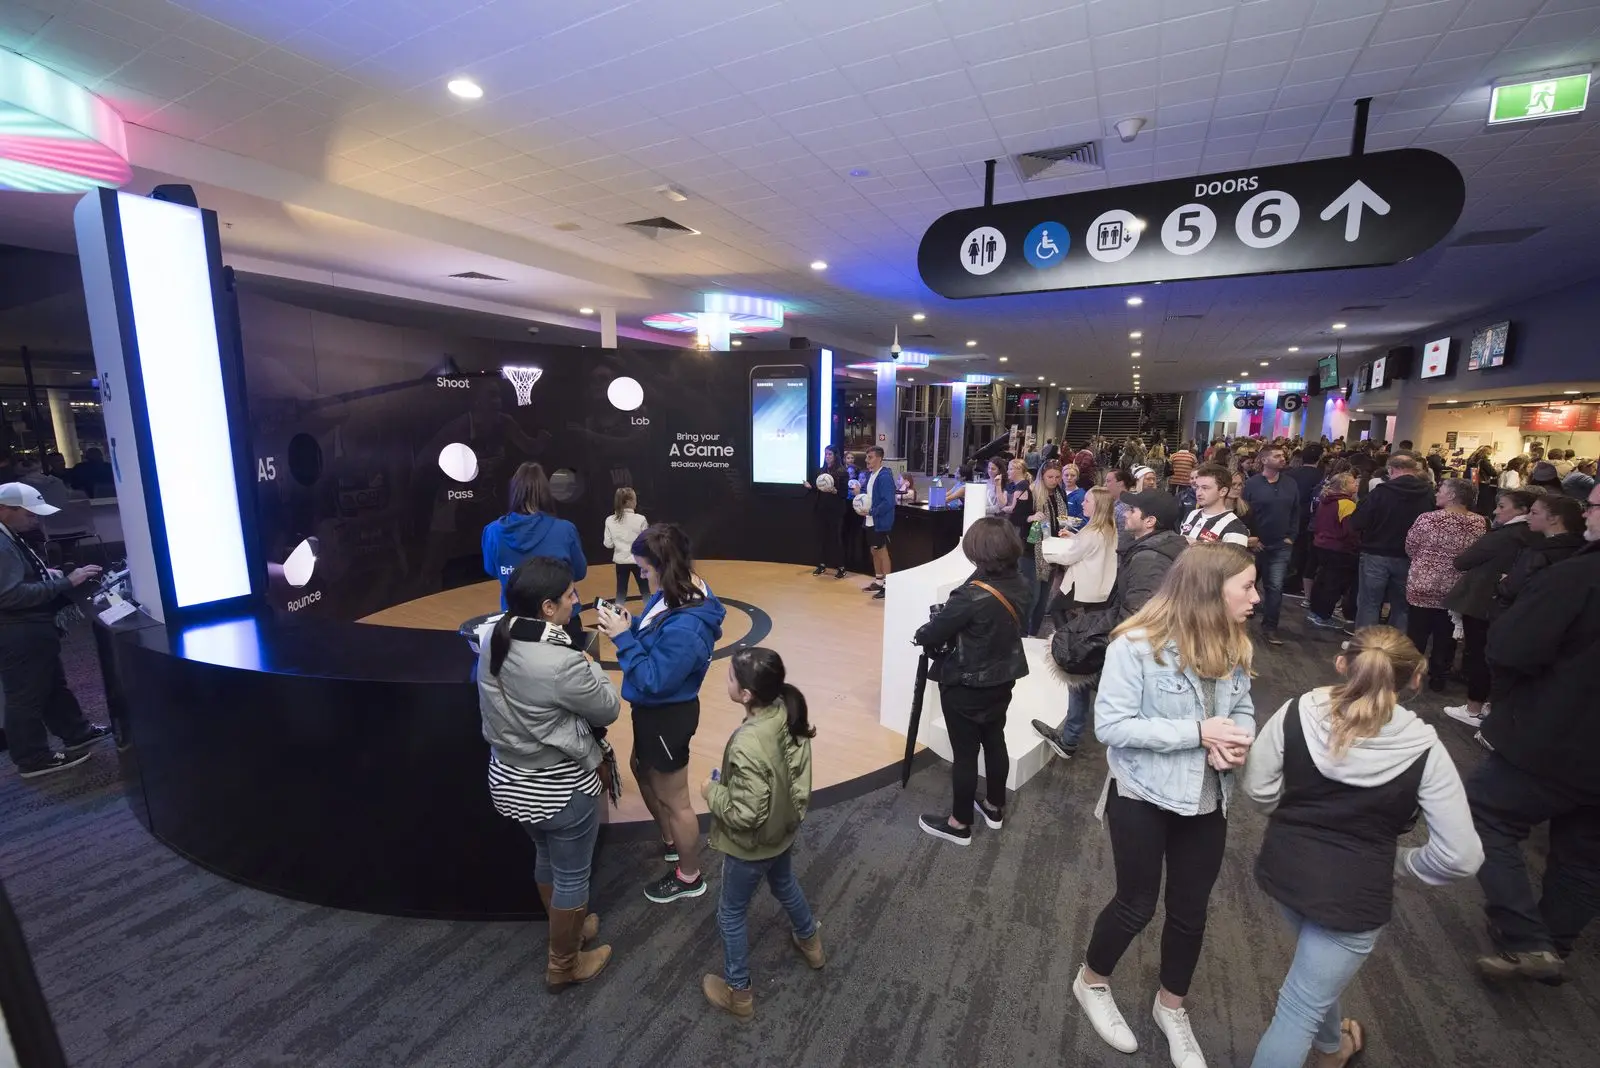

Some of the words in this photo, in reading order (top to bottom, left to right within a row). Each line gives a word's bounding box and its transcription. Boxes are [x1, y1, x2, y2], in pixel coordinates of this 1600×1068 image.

[1195, 176, 1259, 197] DOORS
[1175, 211, 1201, 248] 5
[1251, 198, 1281, 239] 6
[436, 376, 470, 389] Shoot
[1284, 396, 1297, 410] 6
[631, 416, 650, 426] Lob
[676, 432, 699, 442] Bring
[701, 433, 720, 443] your
[669, 443, 680, 457] A
[683, 443, 734, 457] Game
[258, 456, 276, 482] A5
[670, 461, 730, 470] #GalaxyAGame
[448, 490, 474, 500] Pass
[287, 589, 322, 613] Bounce
